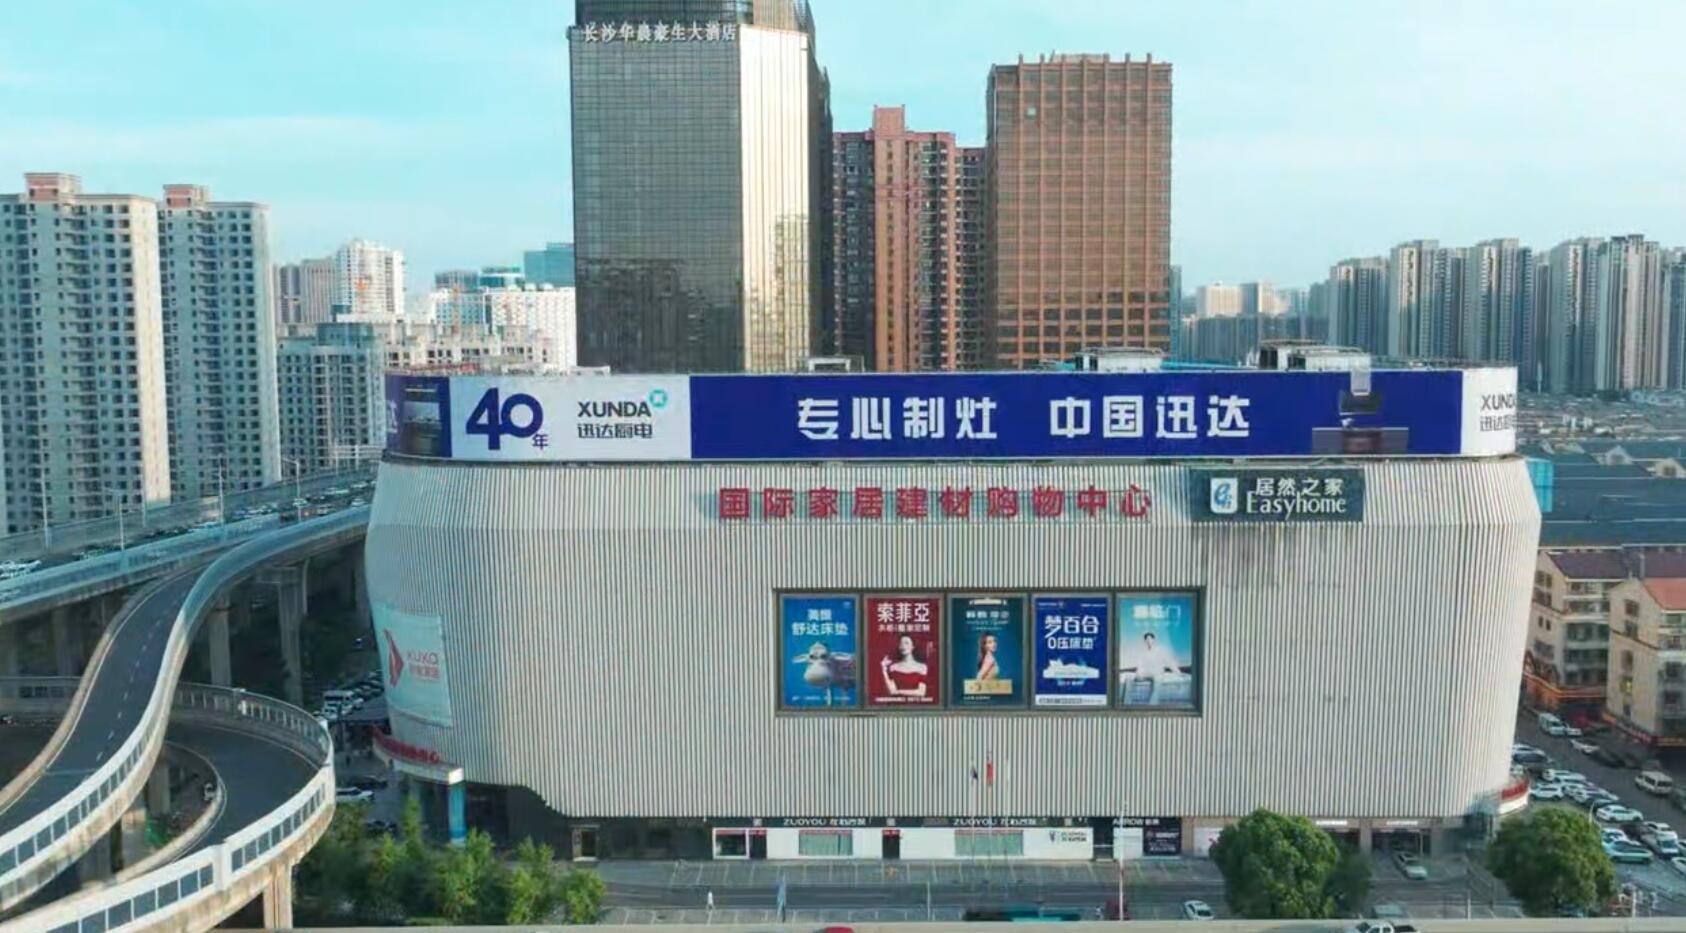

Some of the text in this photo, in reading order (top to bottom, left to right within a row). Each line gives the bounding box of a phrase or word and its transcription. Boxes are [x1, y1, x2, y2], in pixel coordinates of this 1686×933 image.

[578, 401, 650, 417] XUNDA
[798, 396, 1250, 440] 专心制灶 中国迅达
[578, 423, 652, 439] 迅达厨电
[1254, 477, 1344, 496] 居然之家
[719, 485, 1152, 520] 国际家居建材购物中心
[1247, 490, 1347, 519] Easyhome
[877, 602, 930, 623] 索菲亞
[791, 622, 849, 636] 舒达床垫
